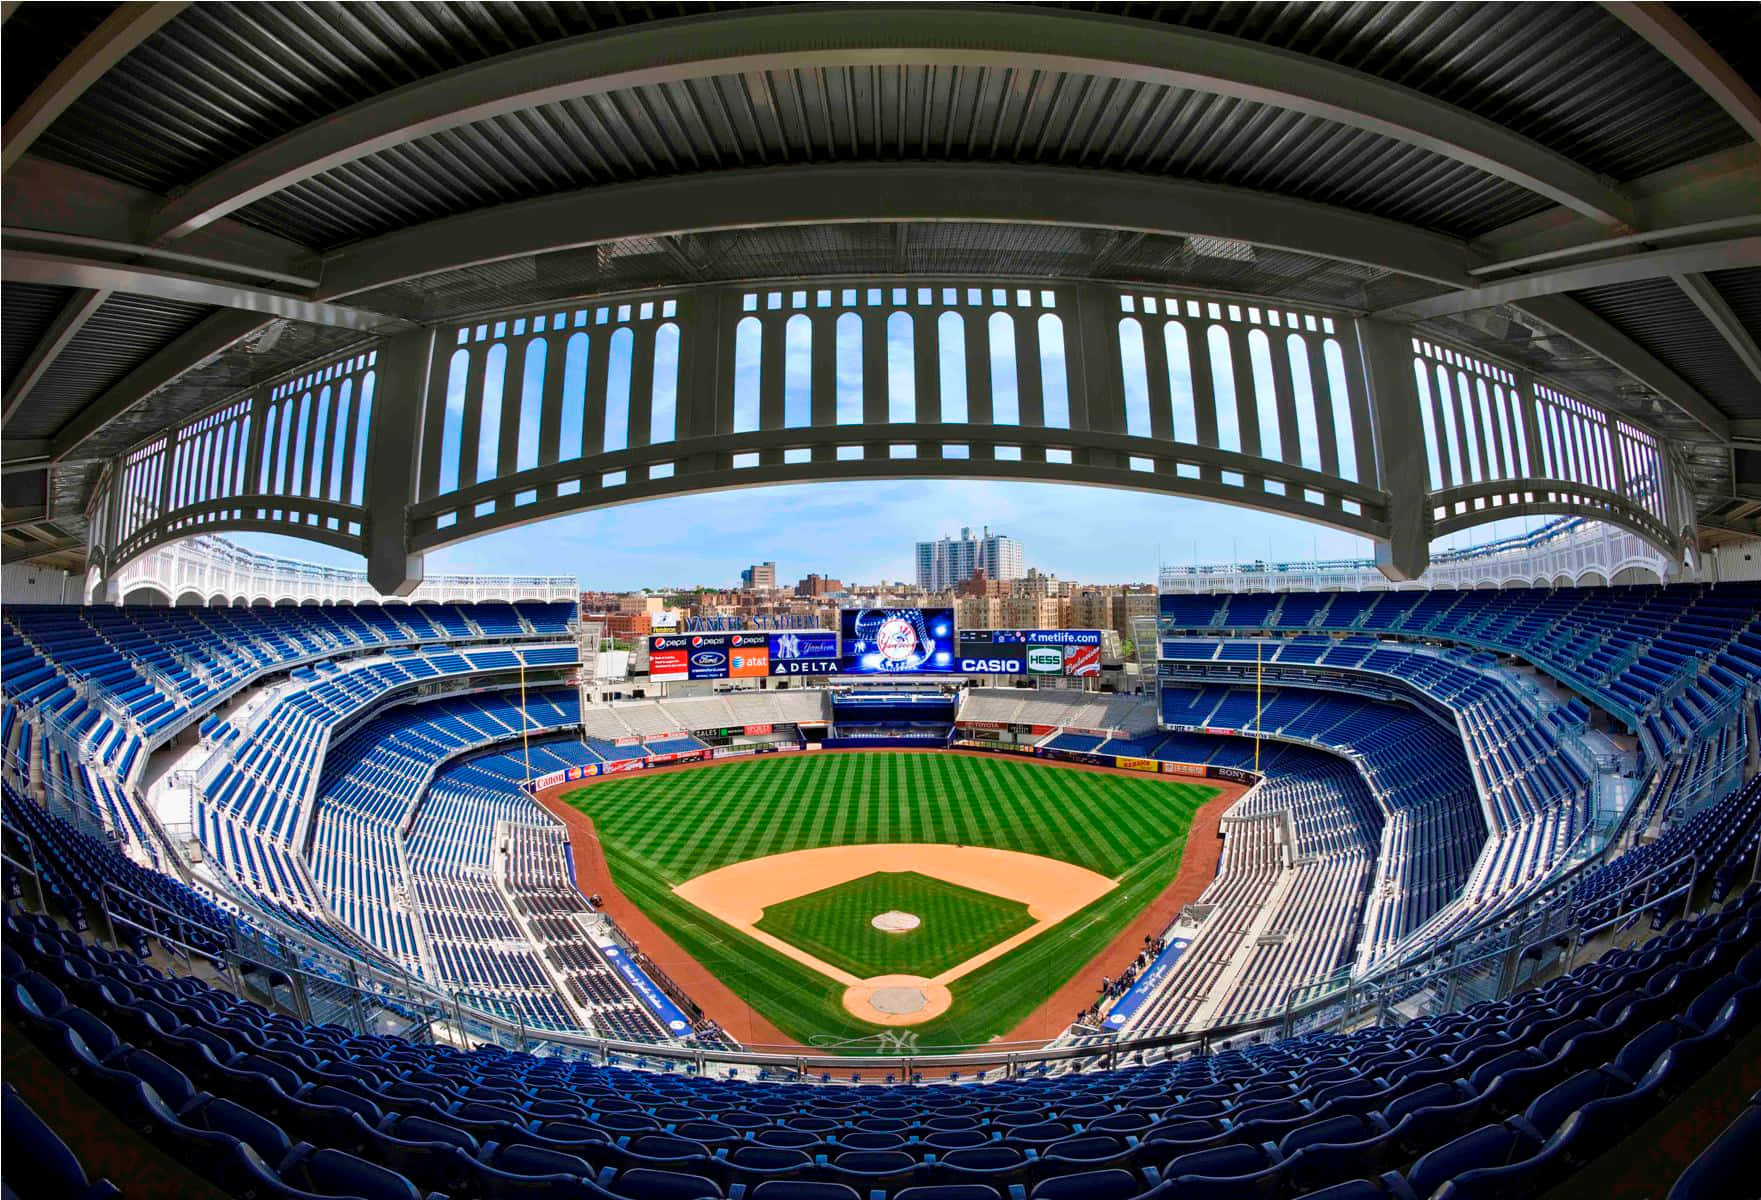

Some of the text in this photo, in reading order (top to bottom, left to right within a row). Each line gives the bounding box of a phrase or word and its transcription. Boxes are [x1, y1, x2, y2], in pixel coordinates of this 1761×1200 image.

[686, 614, 743, 632] YANKEE
[753, 614, 819, 630] STADIUM
[665, 638, 687, 647] pepsi
[703, 637, 724, 646] pepsi
[744, 635, 765, 645] pepsi
[1038, 632, 1098, 643] metlife.com
[746, 657, 767, 666] at&t
[1030, 655, 1060, 664] HESS
[790, 661, 838, 672] DELTA
[961, 659, 1020, 672] CASIO
[1218, 768, 1246, 779] SONY
[537, 774, 564, 788] Canon
